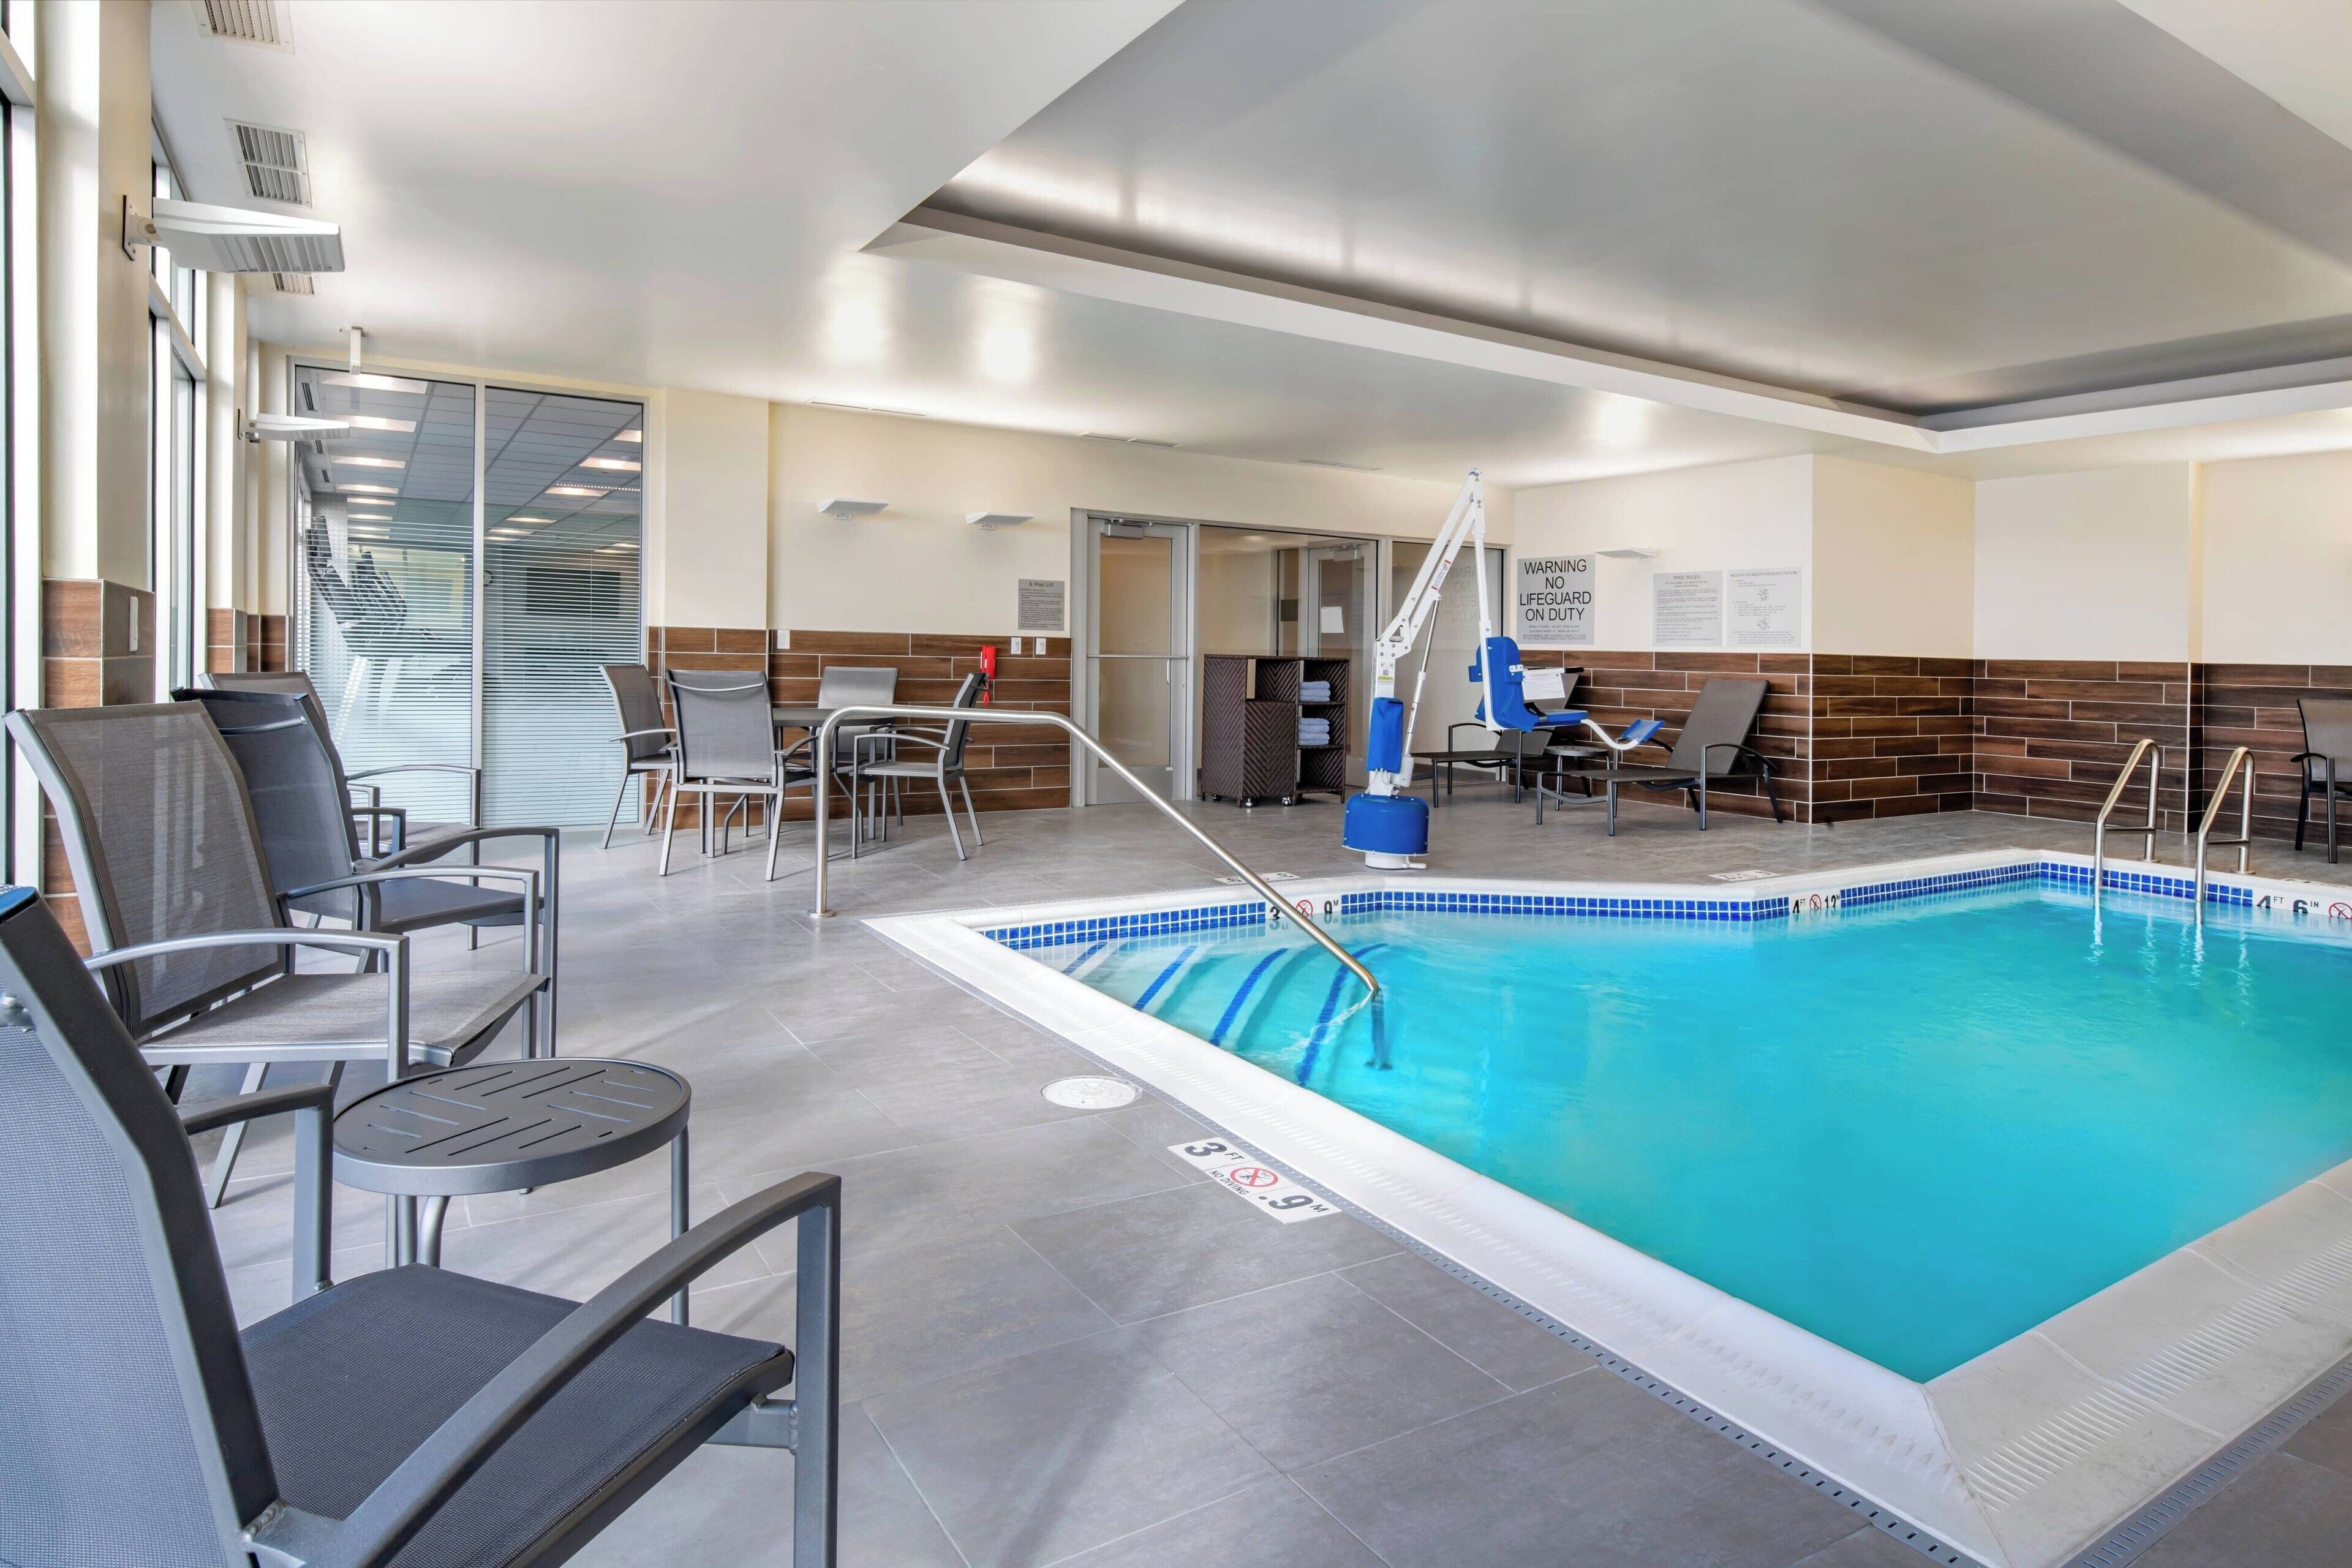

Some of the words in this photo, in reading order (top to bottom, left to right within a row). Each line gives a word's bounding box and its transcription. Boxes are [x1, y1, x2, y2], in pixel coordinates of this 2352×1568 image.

[1525, 559, 1586, 575] WARNING
[1545, 576, 1564, 589] NO
[1520, 592, 1591, 606] LIFEGUARD
[1526, 608, 1544, 621] ON
[1549, 608, 1585, 621] DUTY
[2293, 899, 2309, 914] 6
[1184, 1142, 1227, 1157] 3
[1219, 1178, 1250, 1195] DIVING
[1309, 1204, 1330, 1212] M
